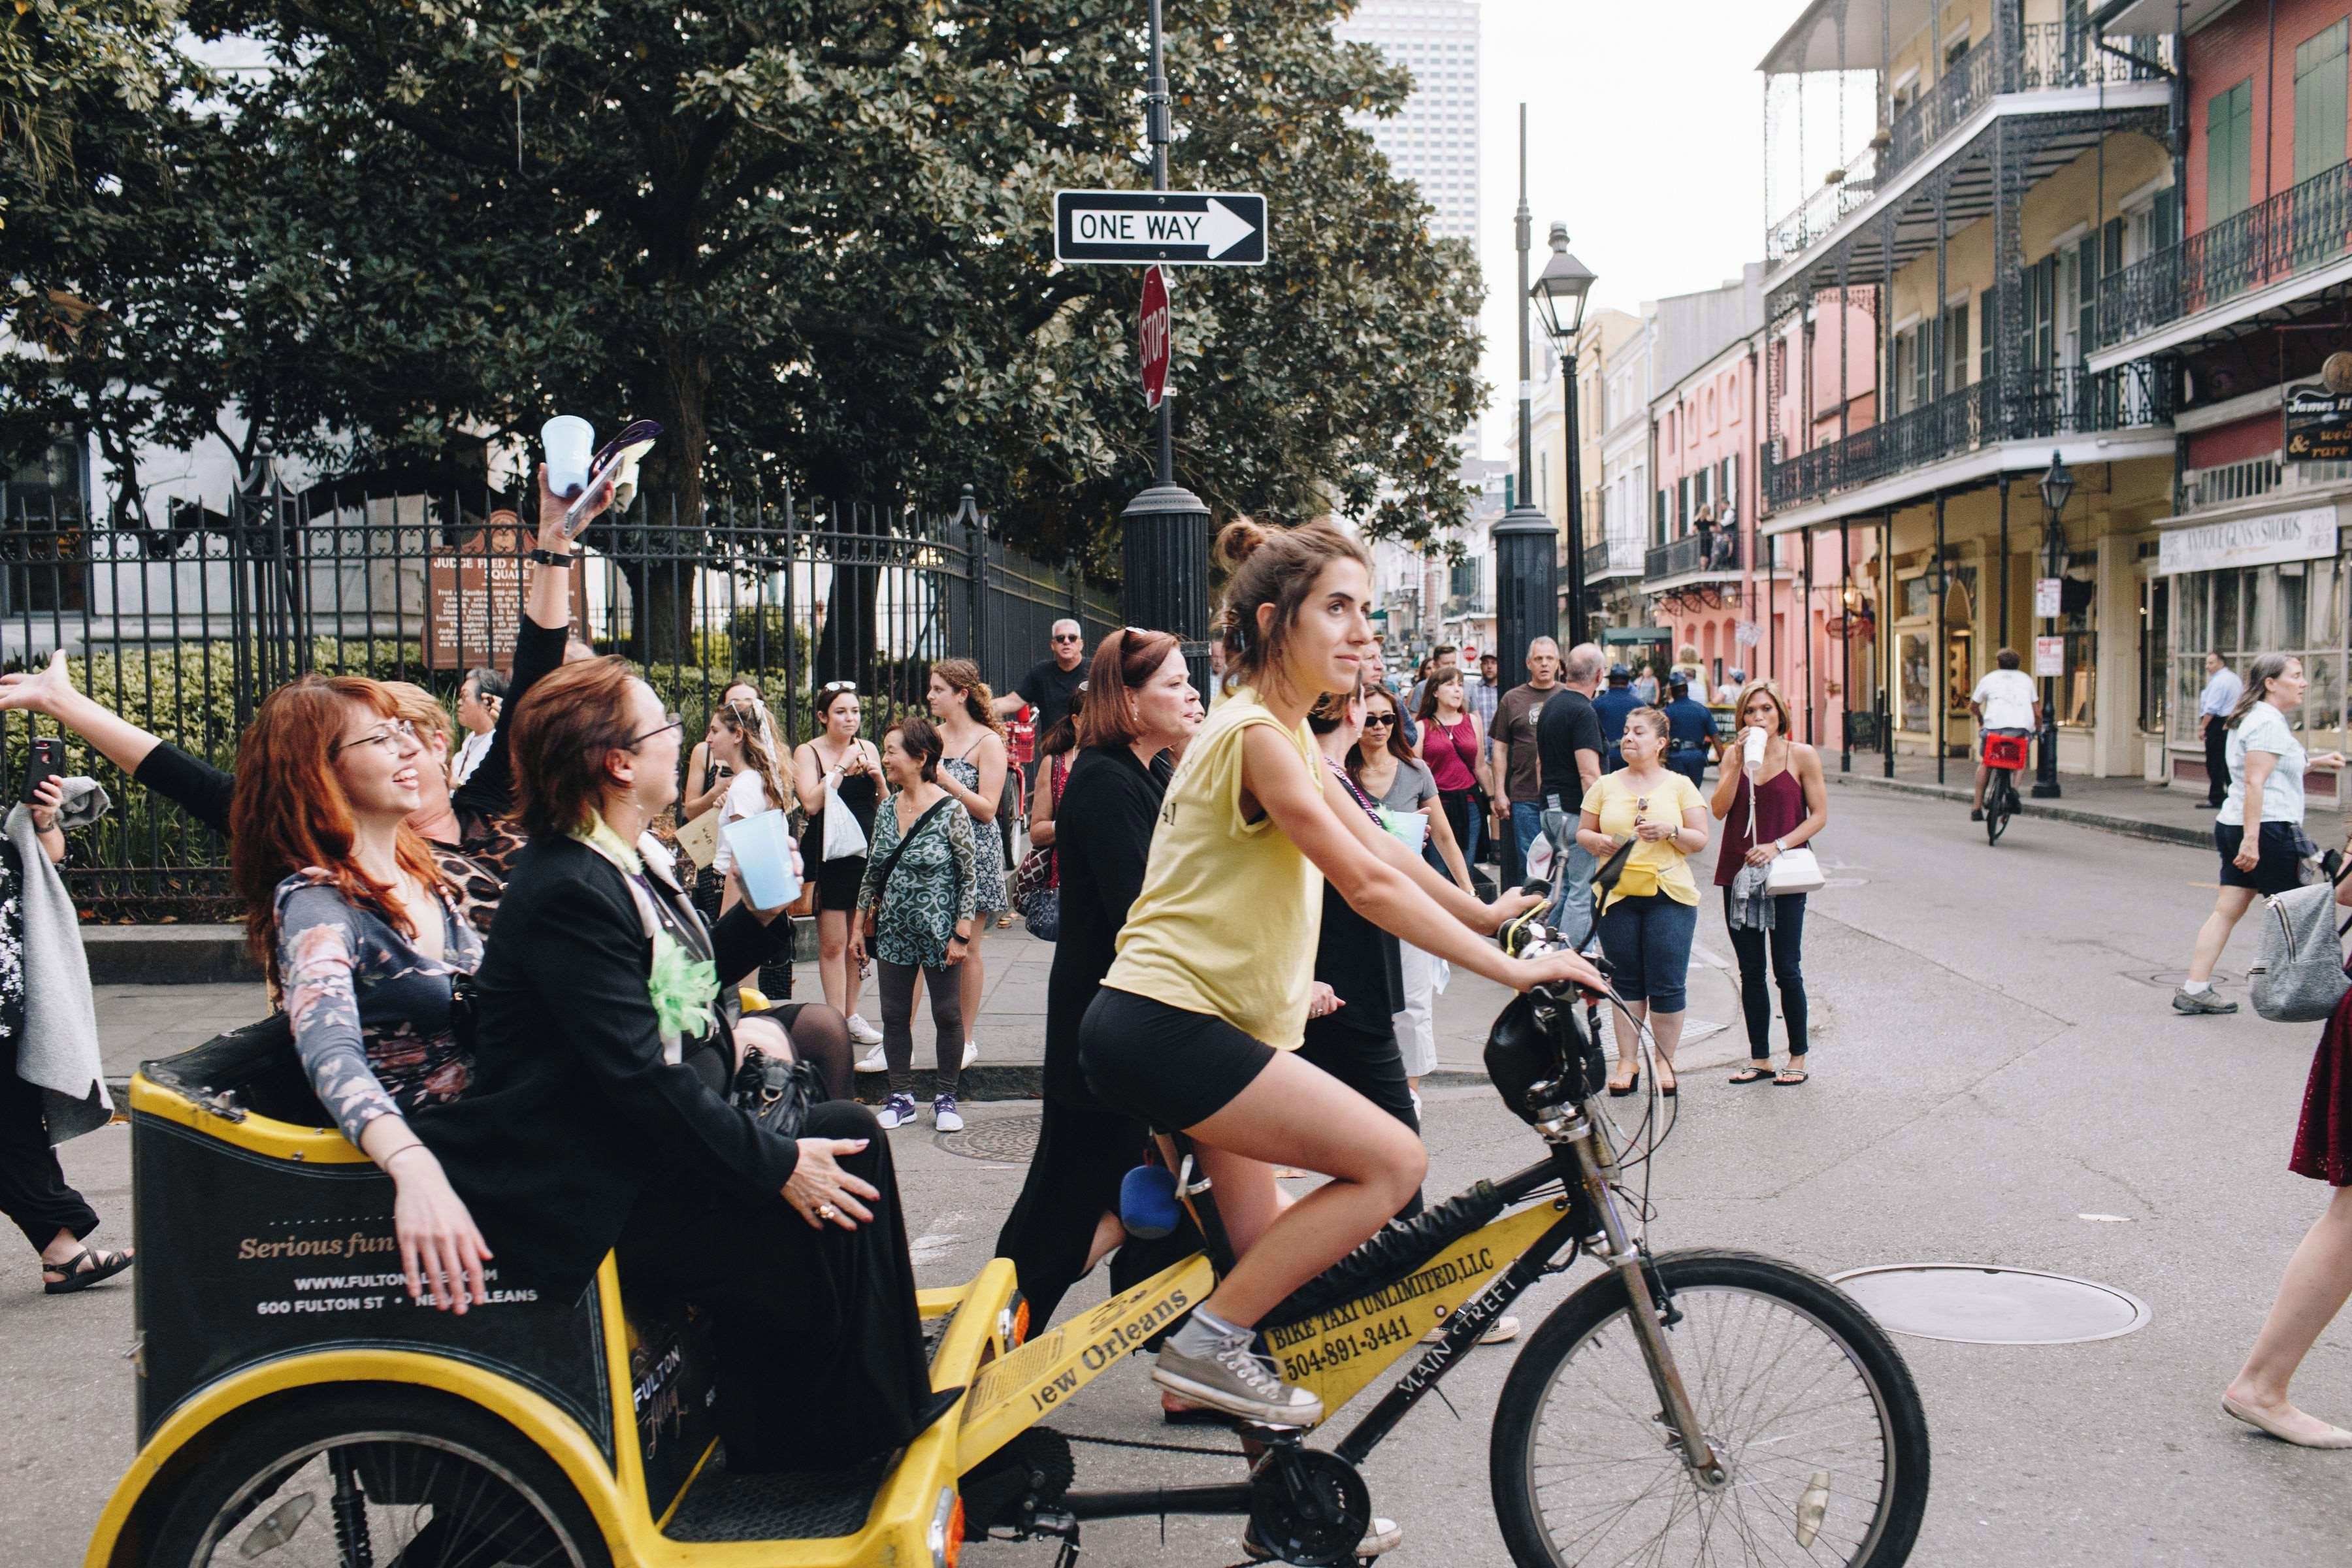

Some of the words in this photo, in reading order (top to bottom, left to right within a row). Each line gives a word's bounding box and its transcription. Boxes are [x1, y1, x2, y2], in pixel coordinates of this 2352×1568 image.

[1080, 214, 1135, 239] ONE
[1147, 215, 1202, 240] WAY
[1141, 306, 1167, 369] STOP
[2288, 399, 2335, 414] James
[2289, 434, 2310, 454] &
[2261, 515, 2302, 545] SWORDS
[238, 1235, 342, 1260] Serious
[344, 1232, 393, 1258] fun
[257, 1301, 291, 1315] 600
[295, 1298, 361, 1313] FULTON
[363, 1296, 385, 1309] ST
[458, 1289, 538, 1305] OLEANS
[1081, 1288, 1188, 1371] Orleans
[1271, 1318, 1316, 1350] BIKE
[1315, 1302, 1362, 1333] TAXI
[1284, 1315, 1413, 1381] 504-891-3441
[632, 1344, 681, 1412] FULTON
[1398, 1339, 1452, 1399] MAIN
